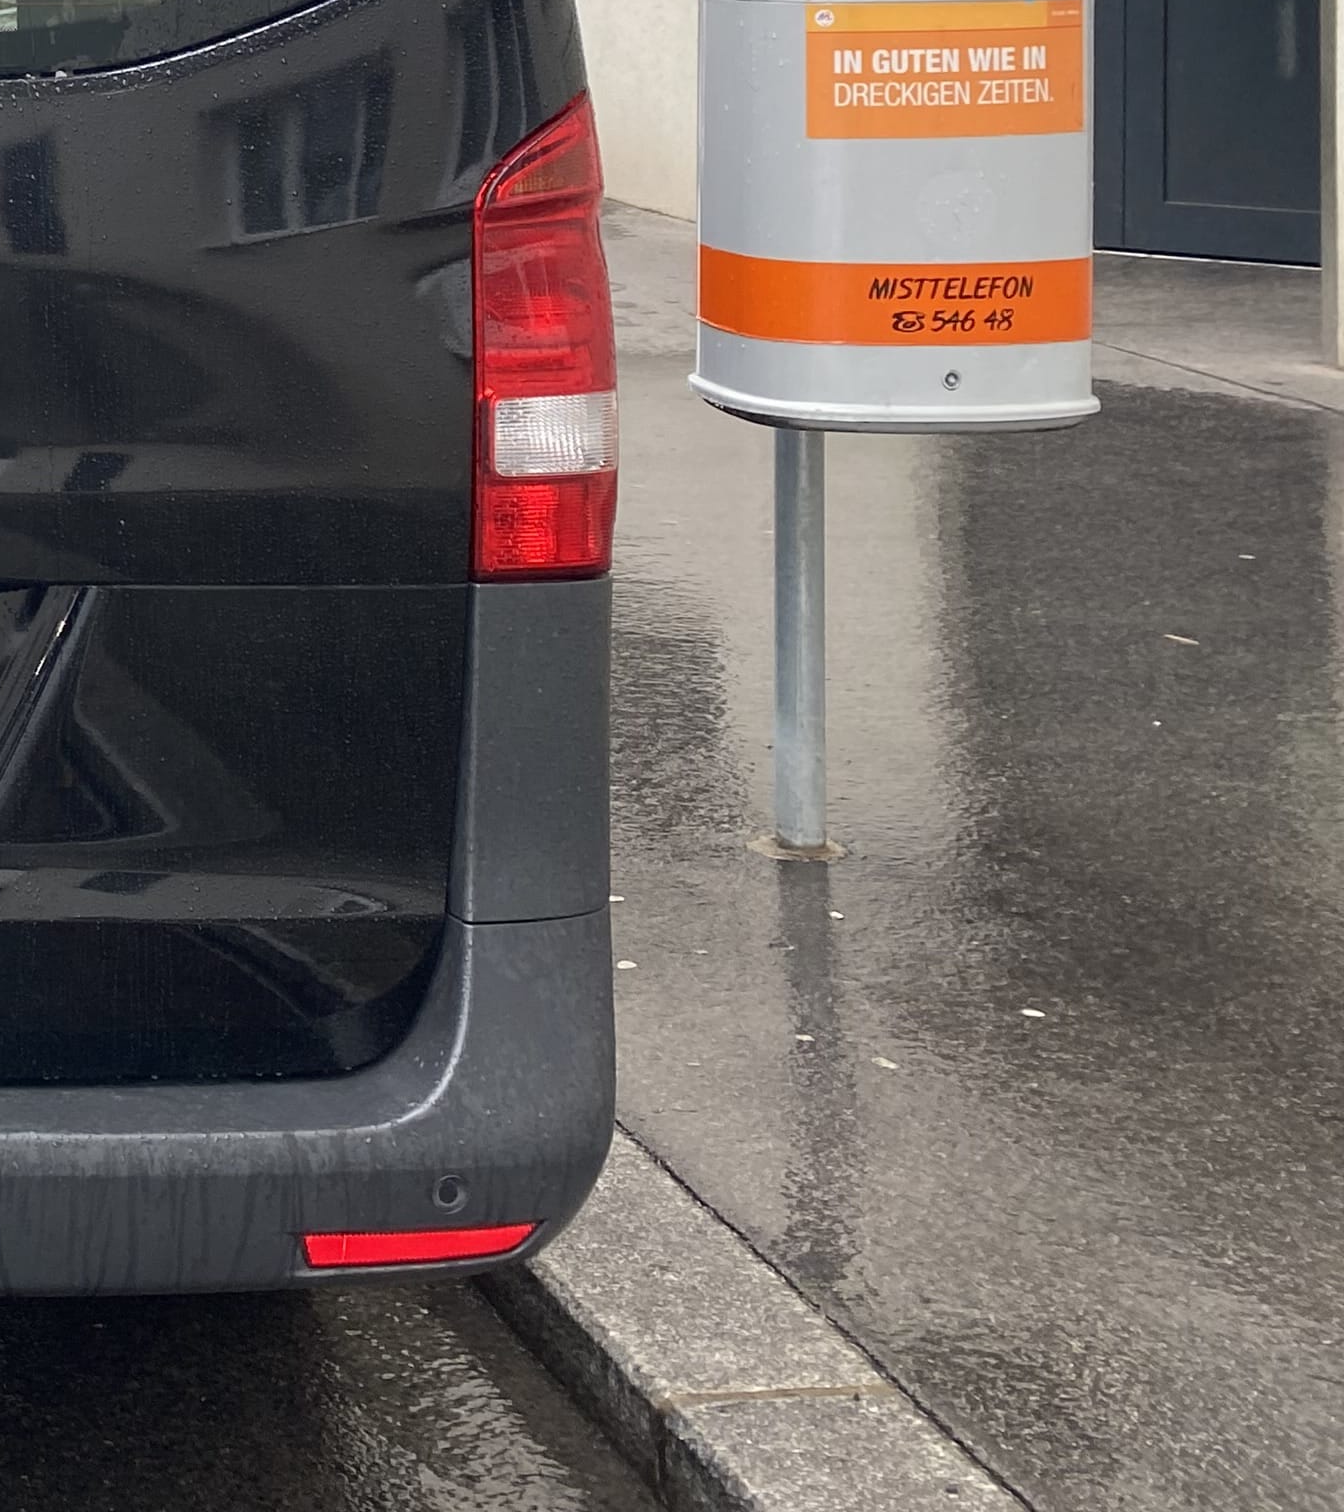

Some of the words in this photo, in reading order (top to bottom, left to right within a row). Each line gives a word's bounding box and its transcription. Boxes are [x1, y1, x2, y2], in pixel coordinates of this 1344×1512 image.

[833, 49, 862, 74] IN
[872, 47, 960, 74] GUTEN
[968, 46, 1016, 73] WIE
[1023, 45, 1046, 70] IN
[834, 80, 971, 107] DRECKIGEN
[977, 78, 1054, 105] ZEITEN.
[868, 275, 1034, 300] MISTTELEFON
[931, 309, 976, 332] 546
[983, 308, 1014, 331] 48
